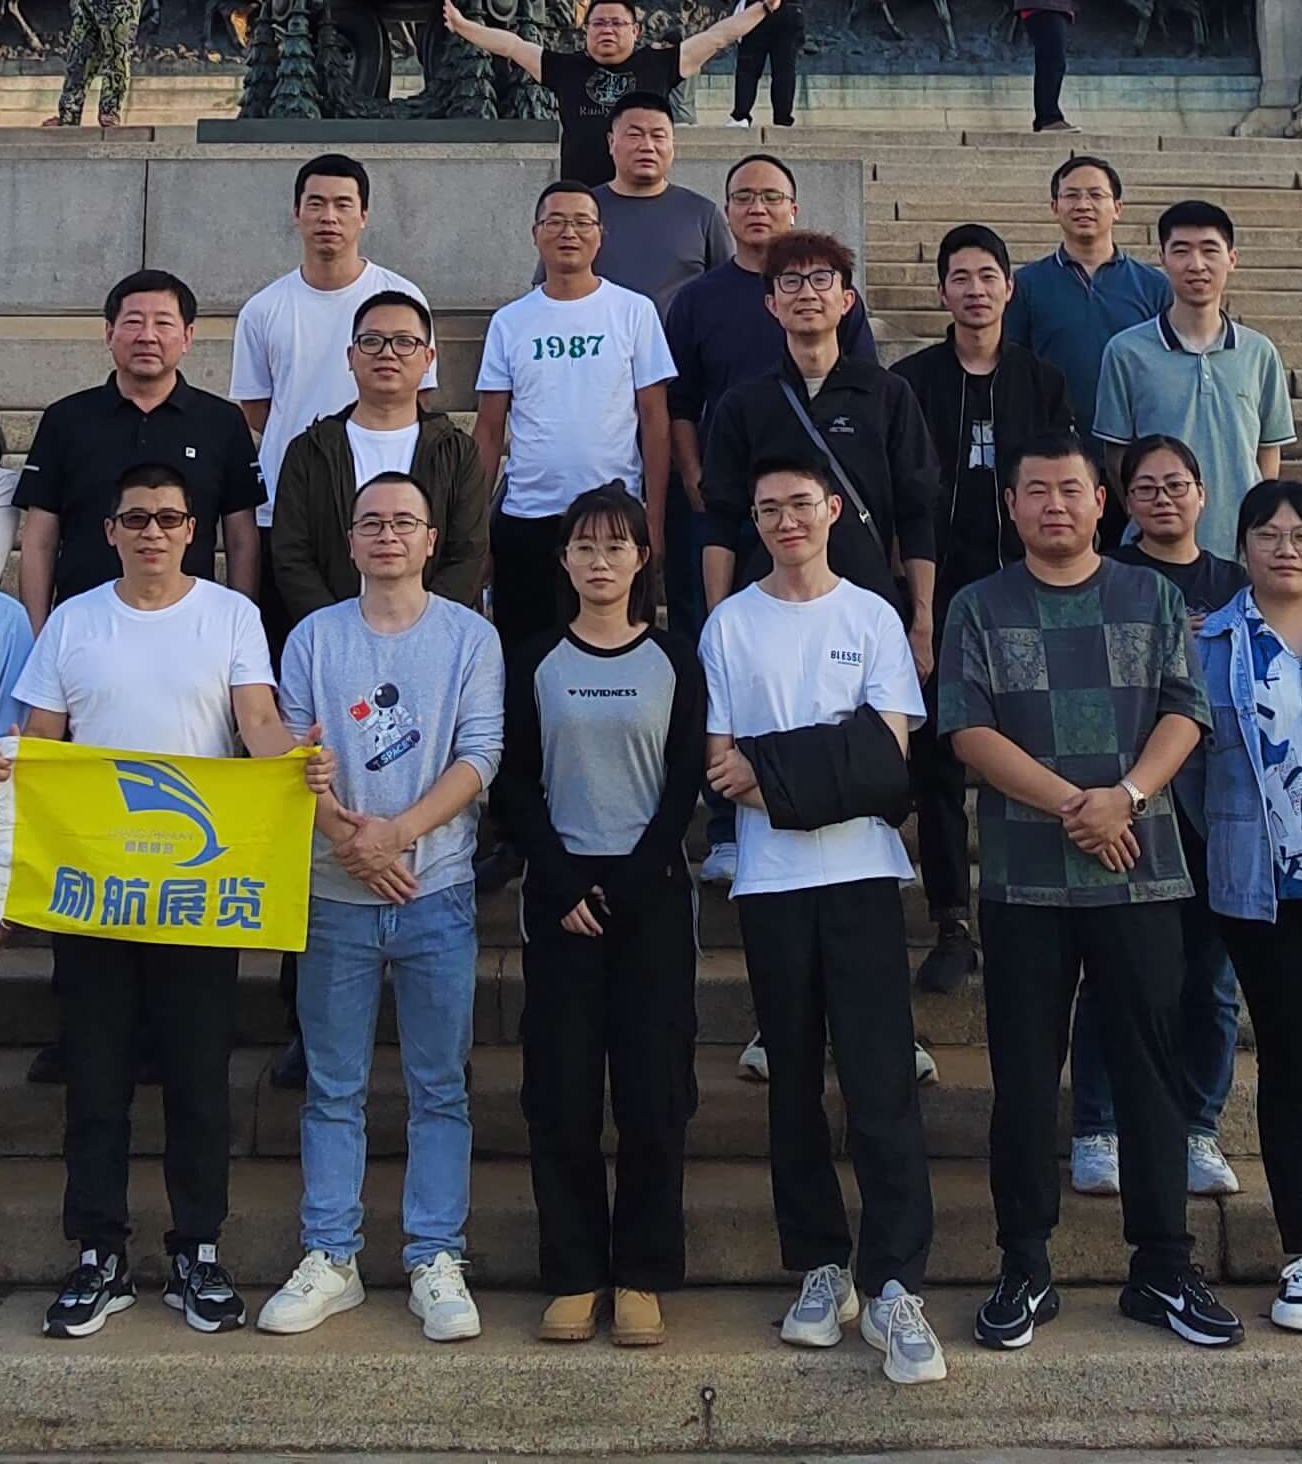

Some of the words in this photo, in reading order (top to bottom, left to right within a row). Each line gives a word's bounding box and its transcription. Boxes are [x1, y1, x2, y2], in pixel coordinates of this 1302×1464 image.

[531, 334, 605, 360] 1987
[579, 688, 637, 697] VIVIDNESS
[380, 739, 410, 764] SPACE
[48, 866, 266, 929] 励航展览
